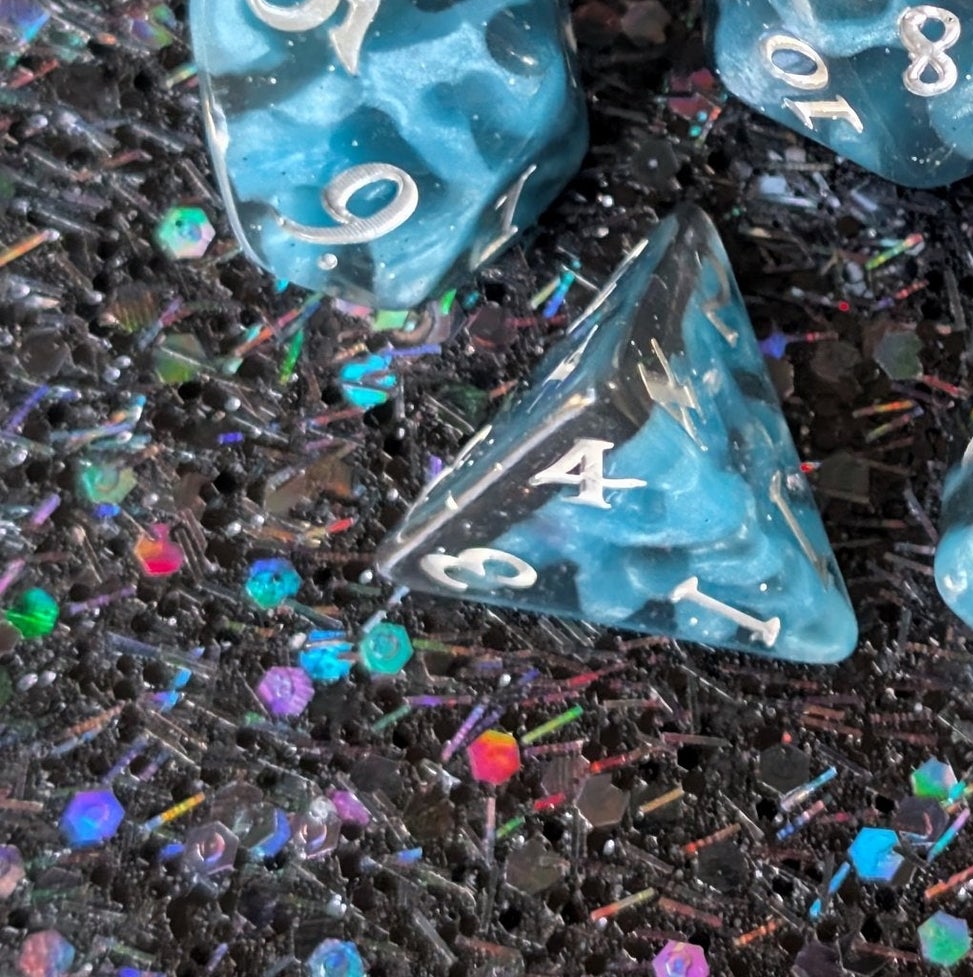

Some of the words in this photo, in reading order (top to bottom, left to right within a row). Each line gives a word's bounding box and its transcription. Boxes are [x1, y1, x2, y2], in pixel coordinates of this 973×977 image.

[761, 34, 863, 134] 10
[902, 5, 961, 97] 8
[529, 438, 647, 509] 4
[420, 547, 538, 590] 3
[670, 576, 781, 647] 1
